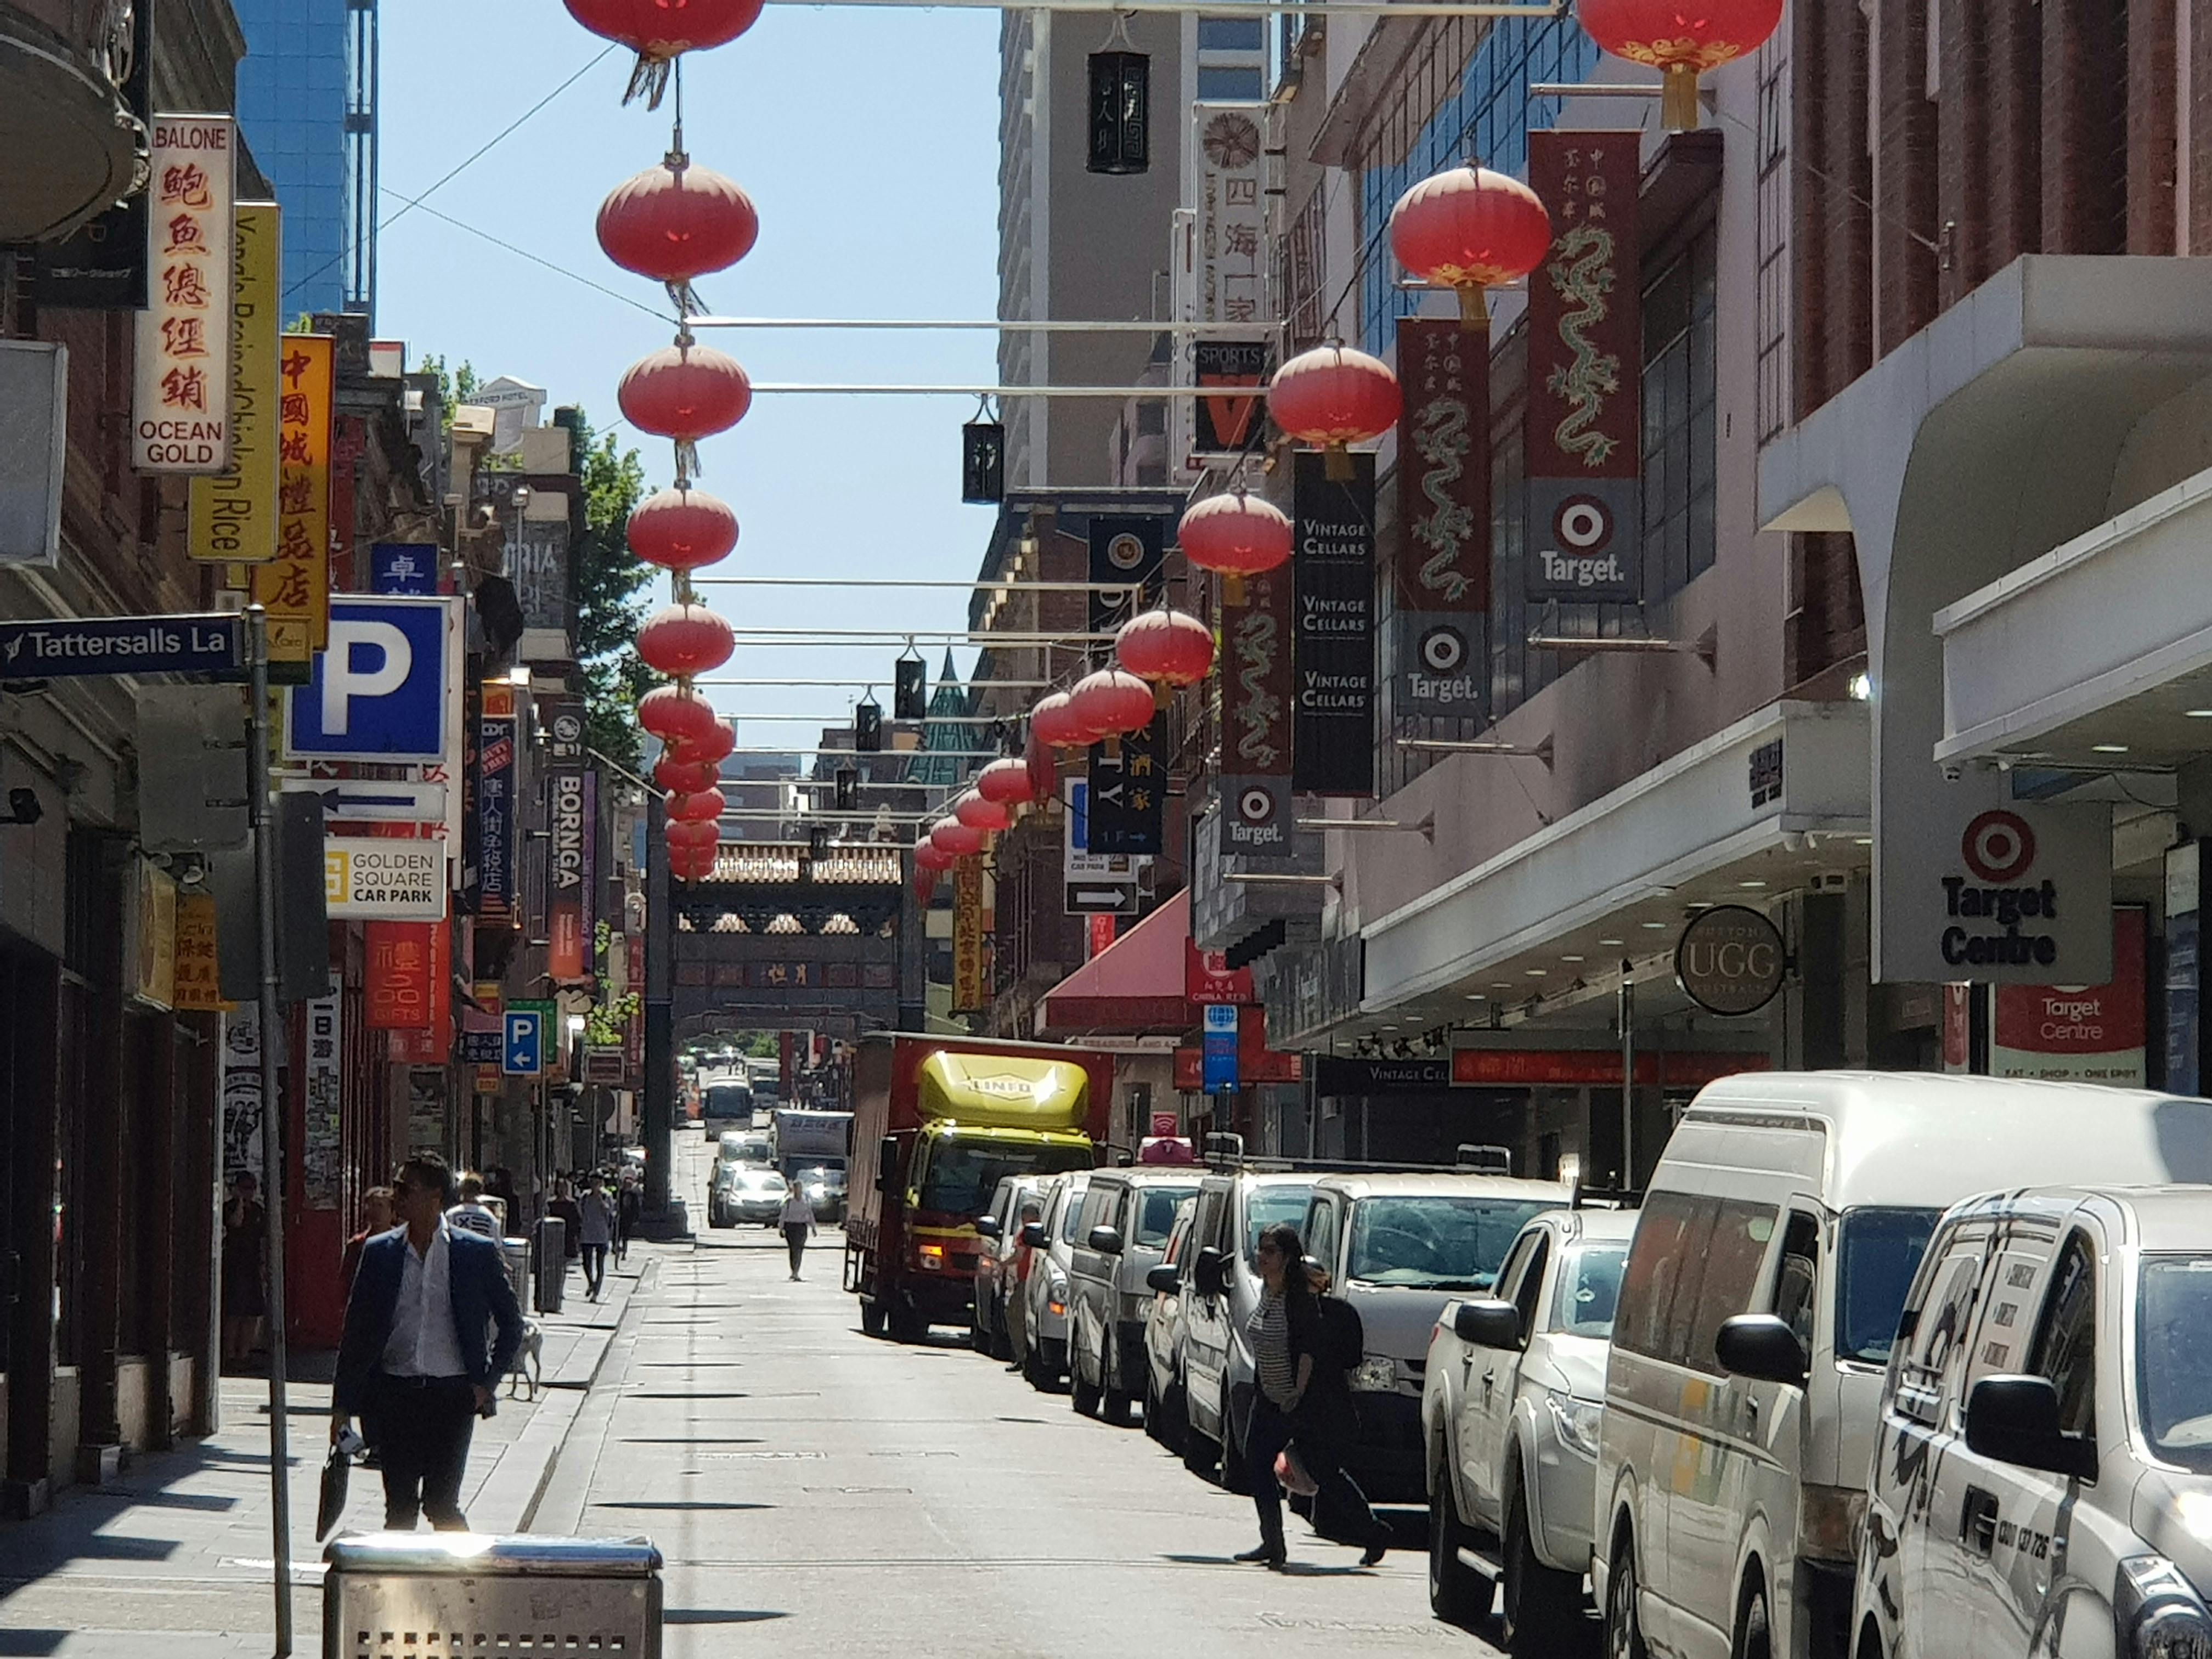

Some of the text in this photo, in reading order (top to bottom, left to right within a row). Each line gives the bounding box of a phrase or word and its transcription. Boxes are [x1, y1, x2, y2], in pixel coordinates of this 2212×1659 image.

[153, 127, 226, 149] BALONE
[1199, 347, 1260, 364] SPORTS
[140, 421, 221, 440] OCEAN
[148, 444, 212, 463] GOLD
[211, 499, 251, 549] Rice
[1303, 520, 1365, 536] VINTAGE
[1303, 538, 1365, 555] CELLARS
[383, 555, 424, 594] 卓
[1303, 595, 1365, 612] VINTAGE
[1303, 614, 1365, 631] CELLARS
[29, 627, 225, 657] Tattersalls La
[322, 620, 412, 735] P
[1305, 671, 1367, 688] VINTAGE
[1302, 690, 1364, 707] CELLARS
[560, 776, 580, 889] BORNGA
[353, 854, 433, 869] GOLDEN
[354, 872, 432, 887] SQUARE
[354, 889, 432, 902] CAR PARK
[1942, 877, 2056, 924] Target
[1941, 926, 2056, 965] Centre
[1690, 943, 1775, 979] UGG
[1192, 993, 1246, 1001] CHINA RED
[2042, 998, 2101, 1022] Target
[512, 1019, 533, 1044] P
[2040, 1022, 2103, 1040] Centre
[1370, 1066, 1419, 1079] VINTAGE
[2005, 1069, 2023, 1077] EAT
[2040, 1069, 2069, 1078] SHOP
